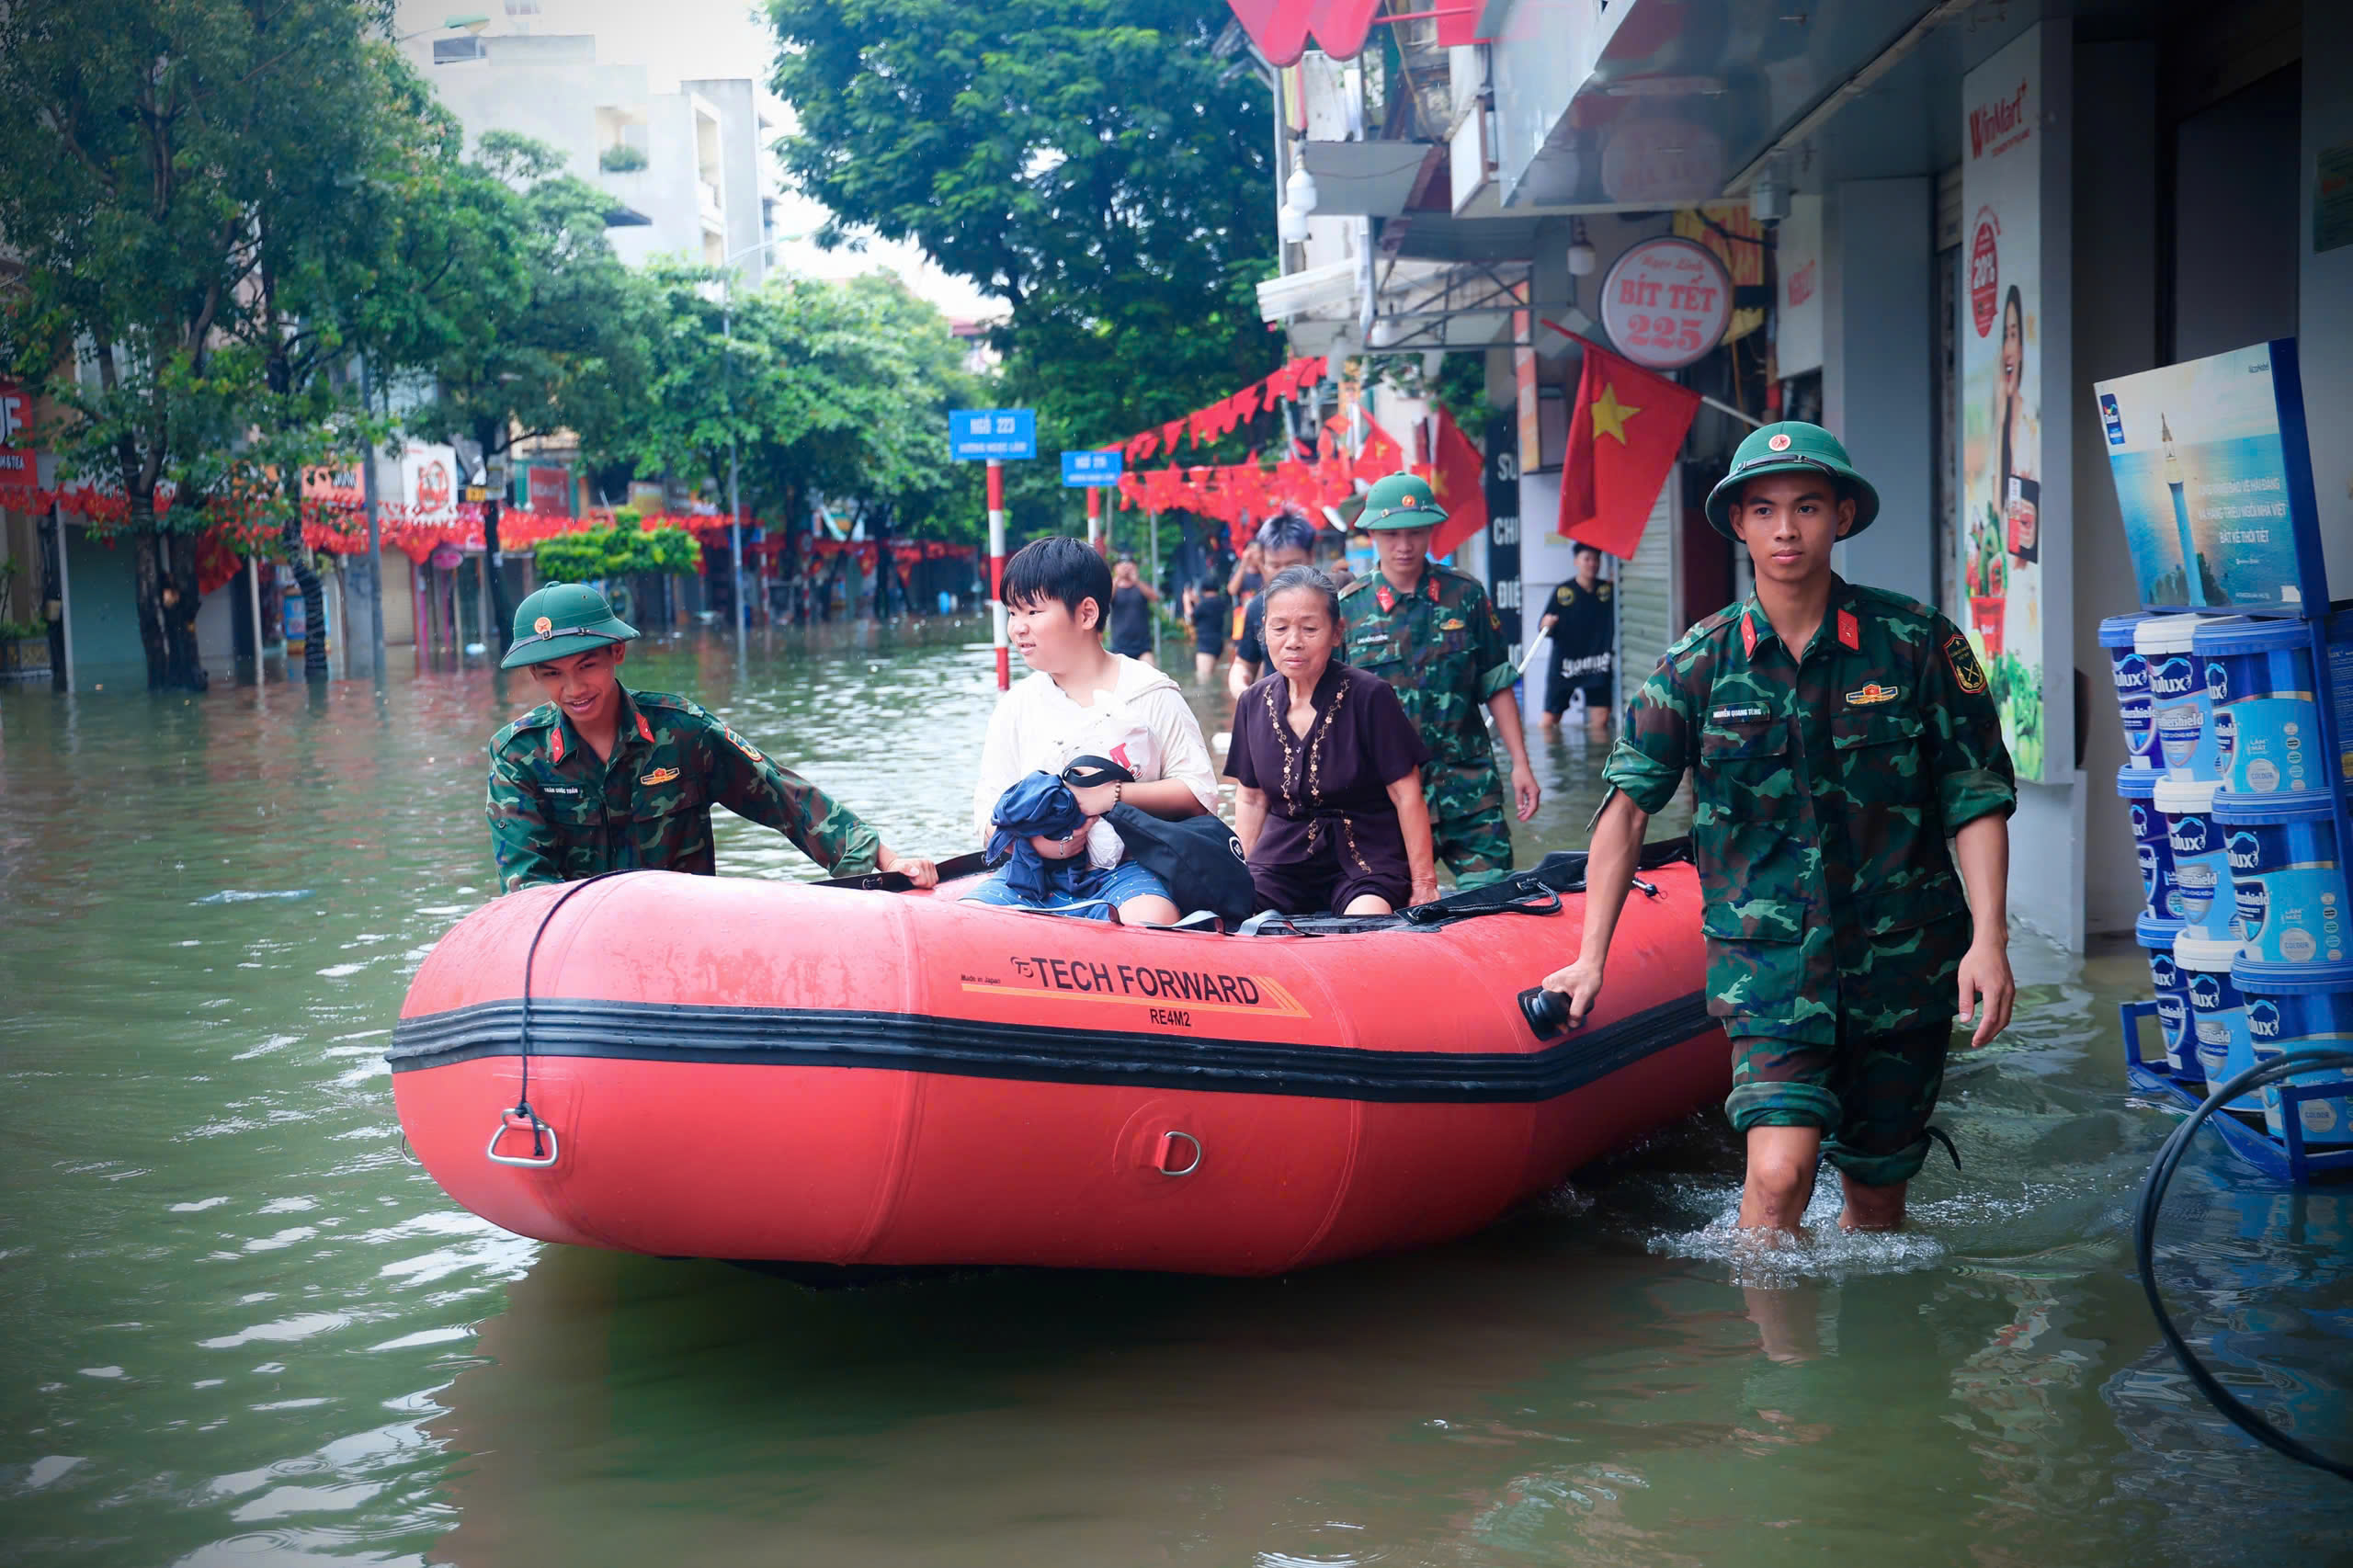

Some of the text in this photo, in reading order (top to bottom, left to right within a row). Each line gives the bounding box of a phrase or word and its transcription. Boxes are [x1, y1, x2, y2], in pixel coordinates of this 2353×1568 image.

[1619, 273, 1718, 312] BÍT TẾT
[1627, 314, 1702, 352] 225
[996, 416, 1016, 434] 223
[984, 976, 1001, 984] Japan
[1030, 957, 1114, 994] TECH
[1117, 965, 1259, 1005] FORWARD
[1150, 1008, 1192, 1028] RE4M2
